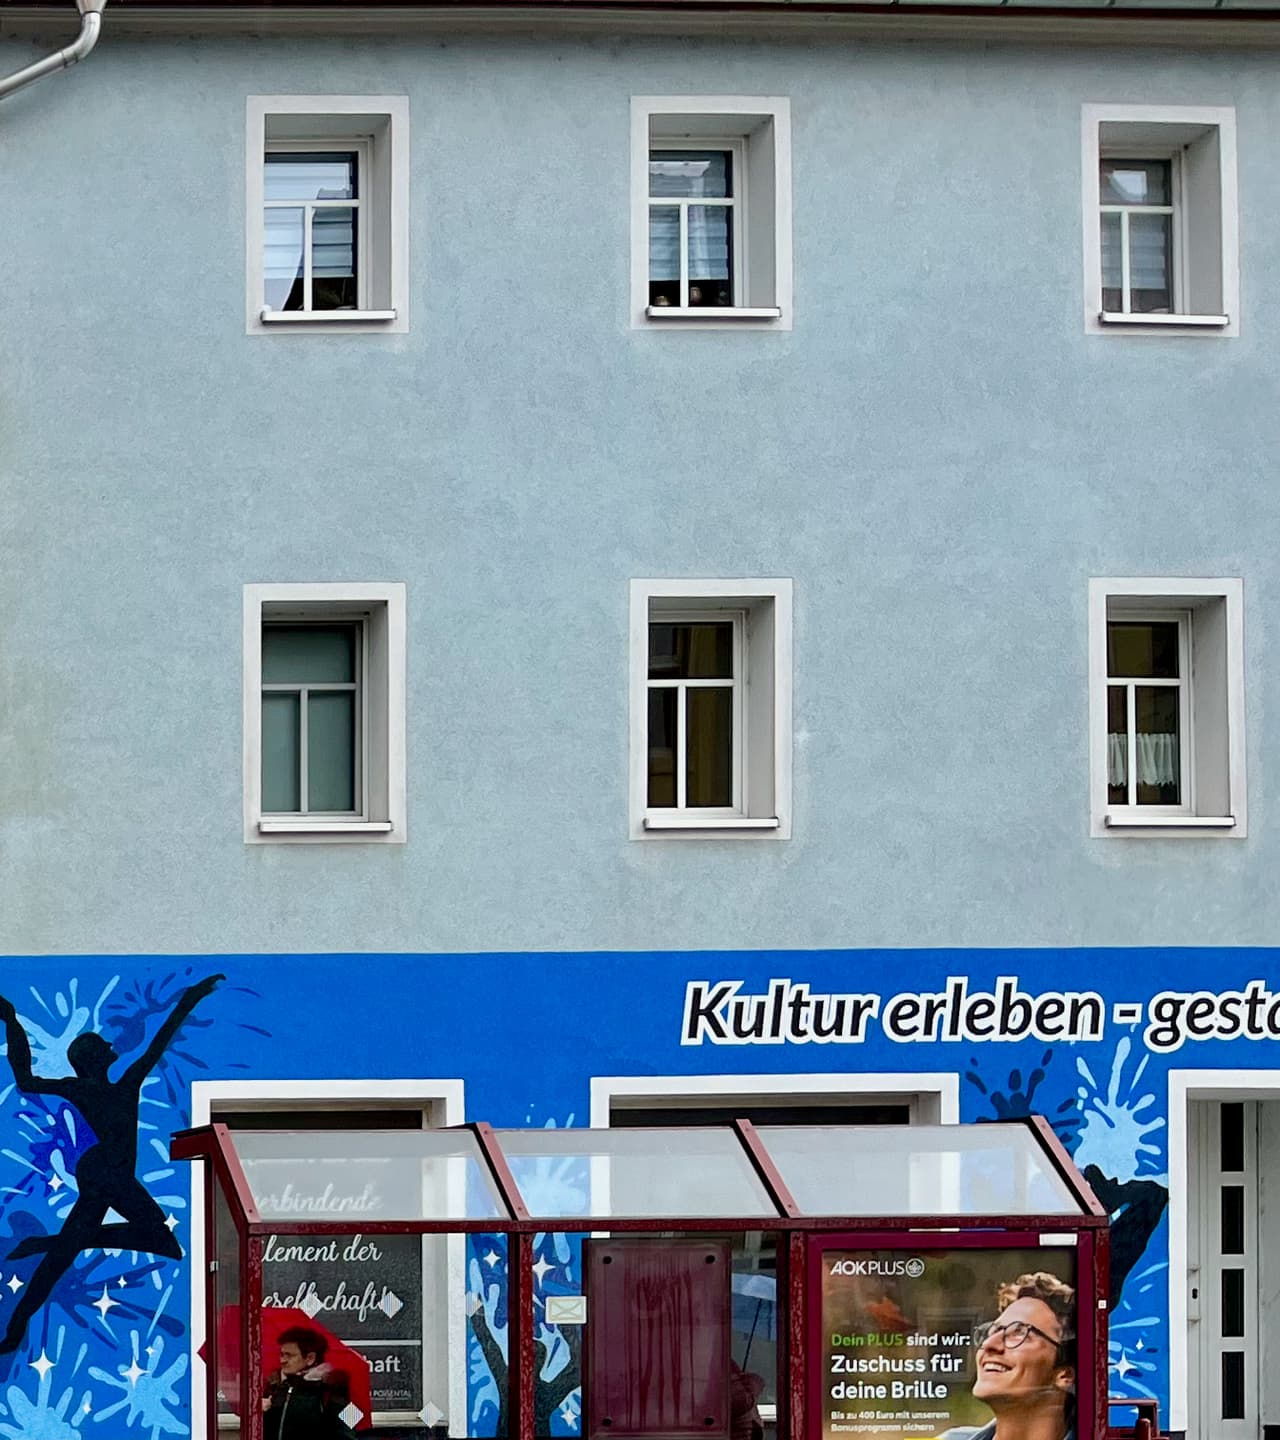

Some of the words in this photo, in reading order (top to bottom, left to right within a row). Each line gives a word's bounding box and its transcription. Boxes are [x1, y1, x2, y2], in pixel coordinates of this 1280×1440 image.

[682, 980, 878, 1043] Kultur
[883, 978, 1103, 1041] erleben
[261, 1234, 340, 1262] lement
[342, 1233, 383, 1262] der
[831, 1333, 864, 1346] Dein
[867, 1333, 903, 1346] PLUS
[906, 1332, 938, 1346] sind
[941, 1332, 971, 1346] wir:
[831, 1355, 926, 1373] Zuschuss
[930, 1354, 963, 1373] für
[831, 1381, 887, 1399] deine
[891, 1381, 948, 1399] Brille
[831, 1411, 845, 1420] Bis
[858, 1411, 875, 1420] 400
[876, 1411, 894, 1420] Euro
[895, 1411, 910, 1420] mit
[911, 1412, 950, 1420] unserem
